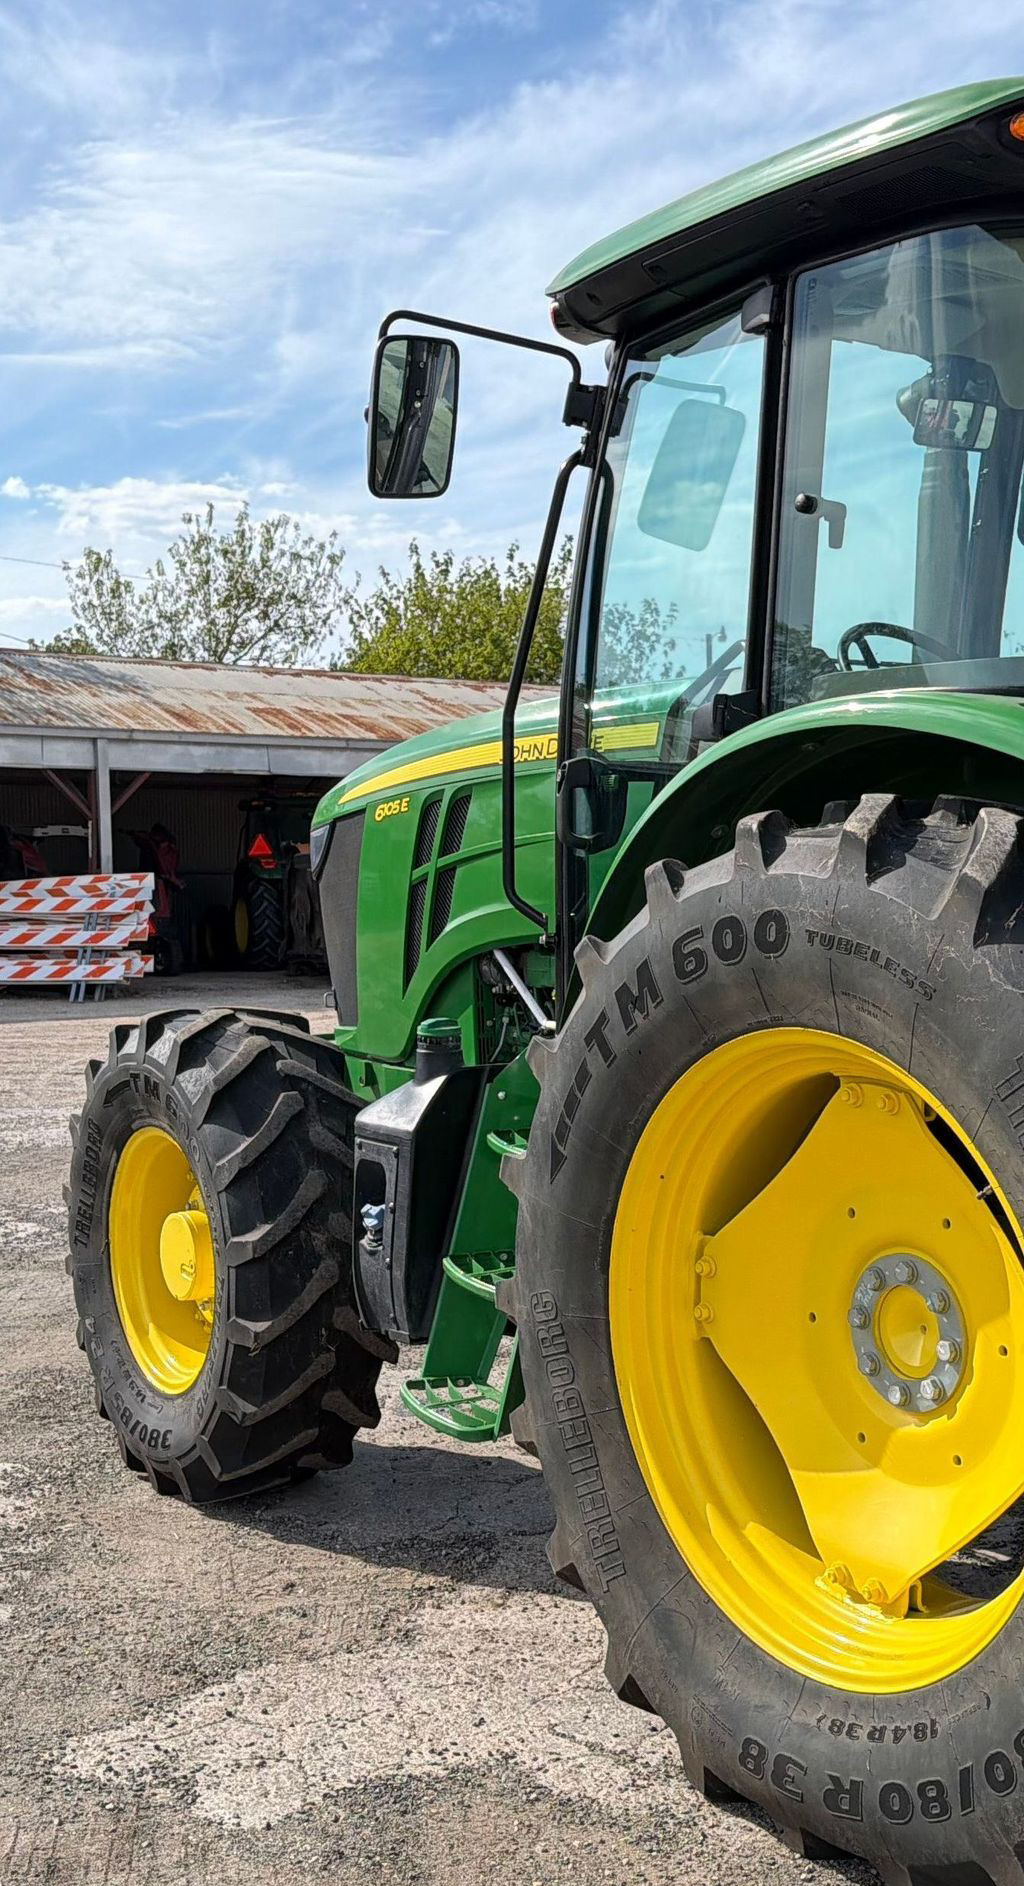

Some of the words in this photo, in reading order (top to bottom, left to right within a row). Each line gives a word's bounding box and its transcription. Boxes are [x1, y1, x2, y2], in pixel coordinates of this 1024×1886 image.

[374, 799, 401, 822] 6105
[400, 797, 410, 812] E
[584, 955, 665, 1070] TM
[671, 907, 791, 984] 600
[804, 928, 939, 1002] TUBELESS
[73, 1118, 103, 1249] TRELLEBORG
[531, 1290, 628, 1593] TRELLEBORG
[737, 1733, 809, 1804] 38
[822, 1771, 865, 1823] R
